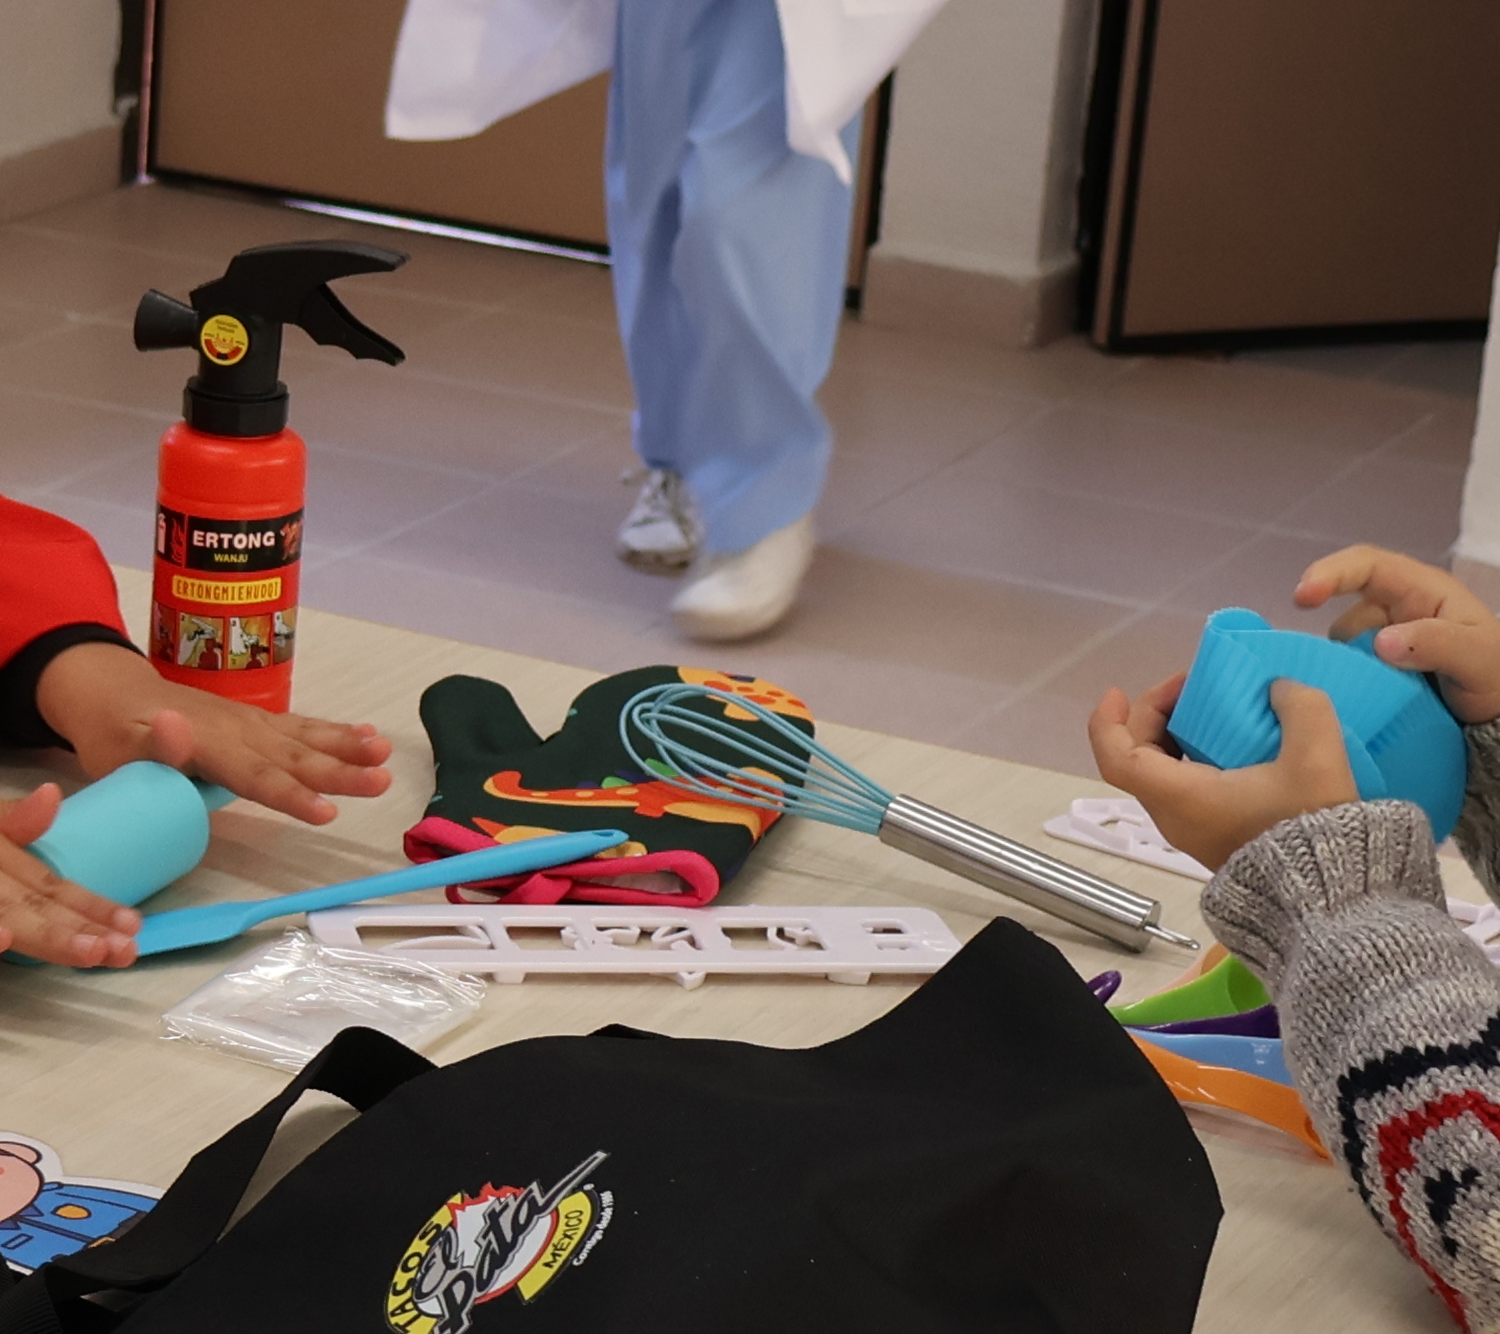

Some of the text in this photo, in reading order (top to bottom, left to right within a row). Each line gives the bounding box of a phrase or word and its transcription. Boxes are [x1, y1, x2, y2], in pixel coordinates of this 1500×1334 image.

[192, 529, 276, 550] ERTONG
[214, 553, 249, 563] WANJU
[541, 1209, 584, 1270] MÉXICO
[389, 1220, 443, 1334] TACOS
